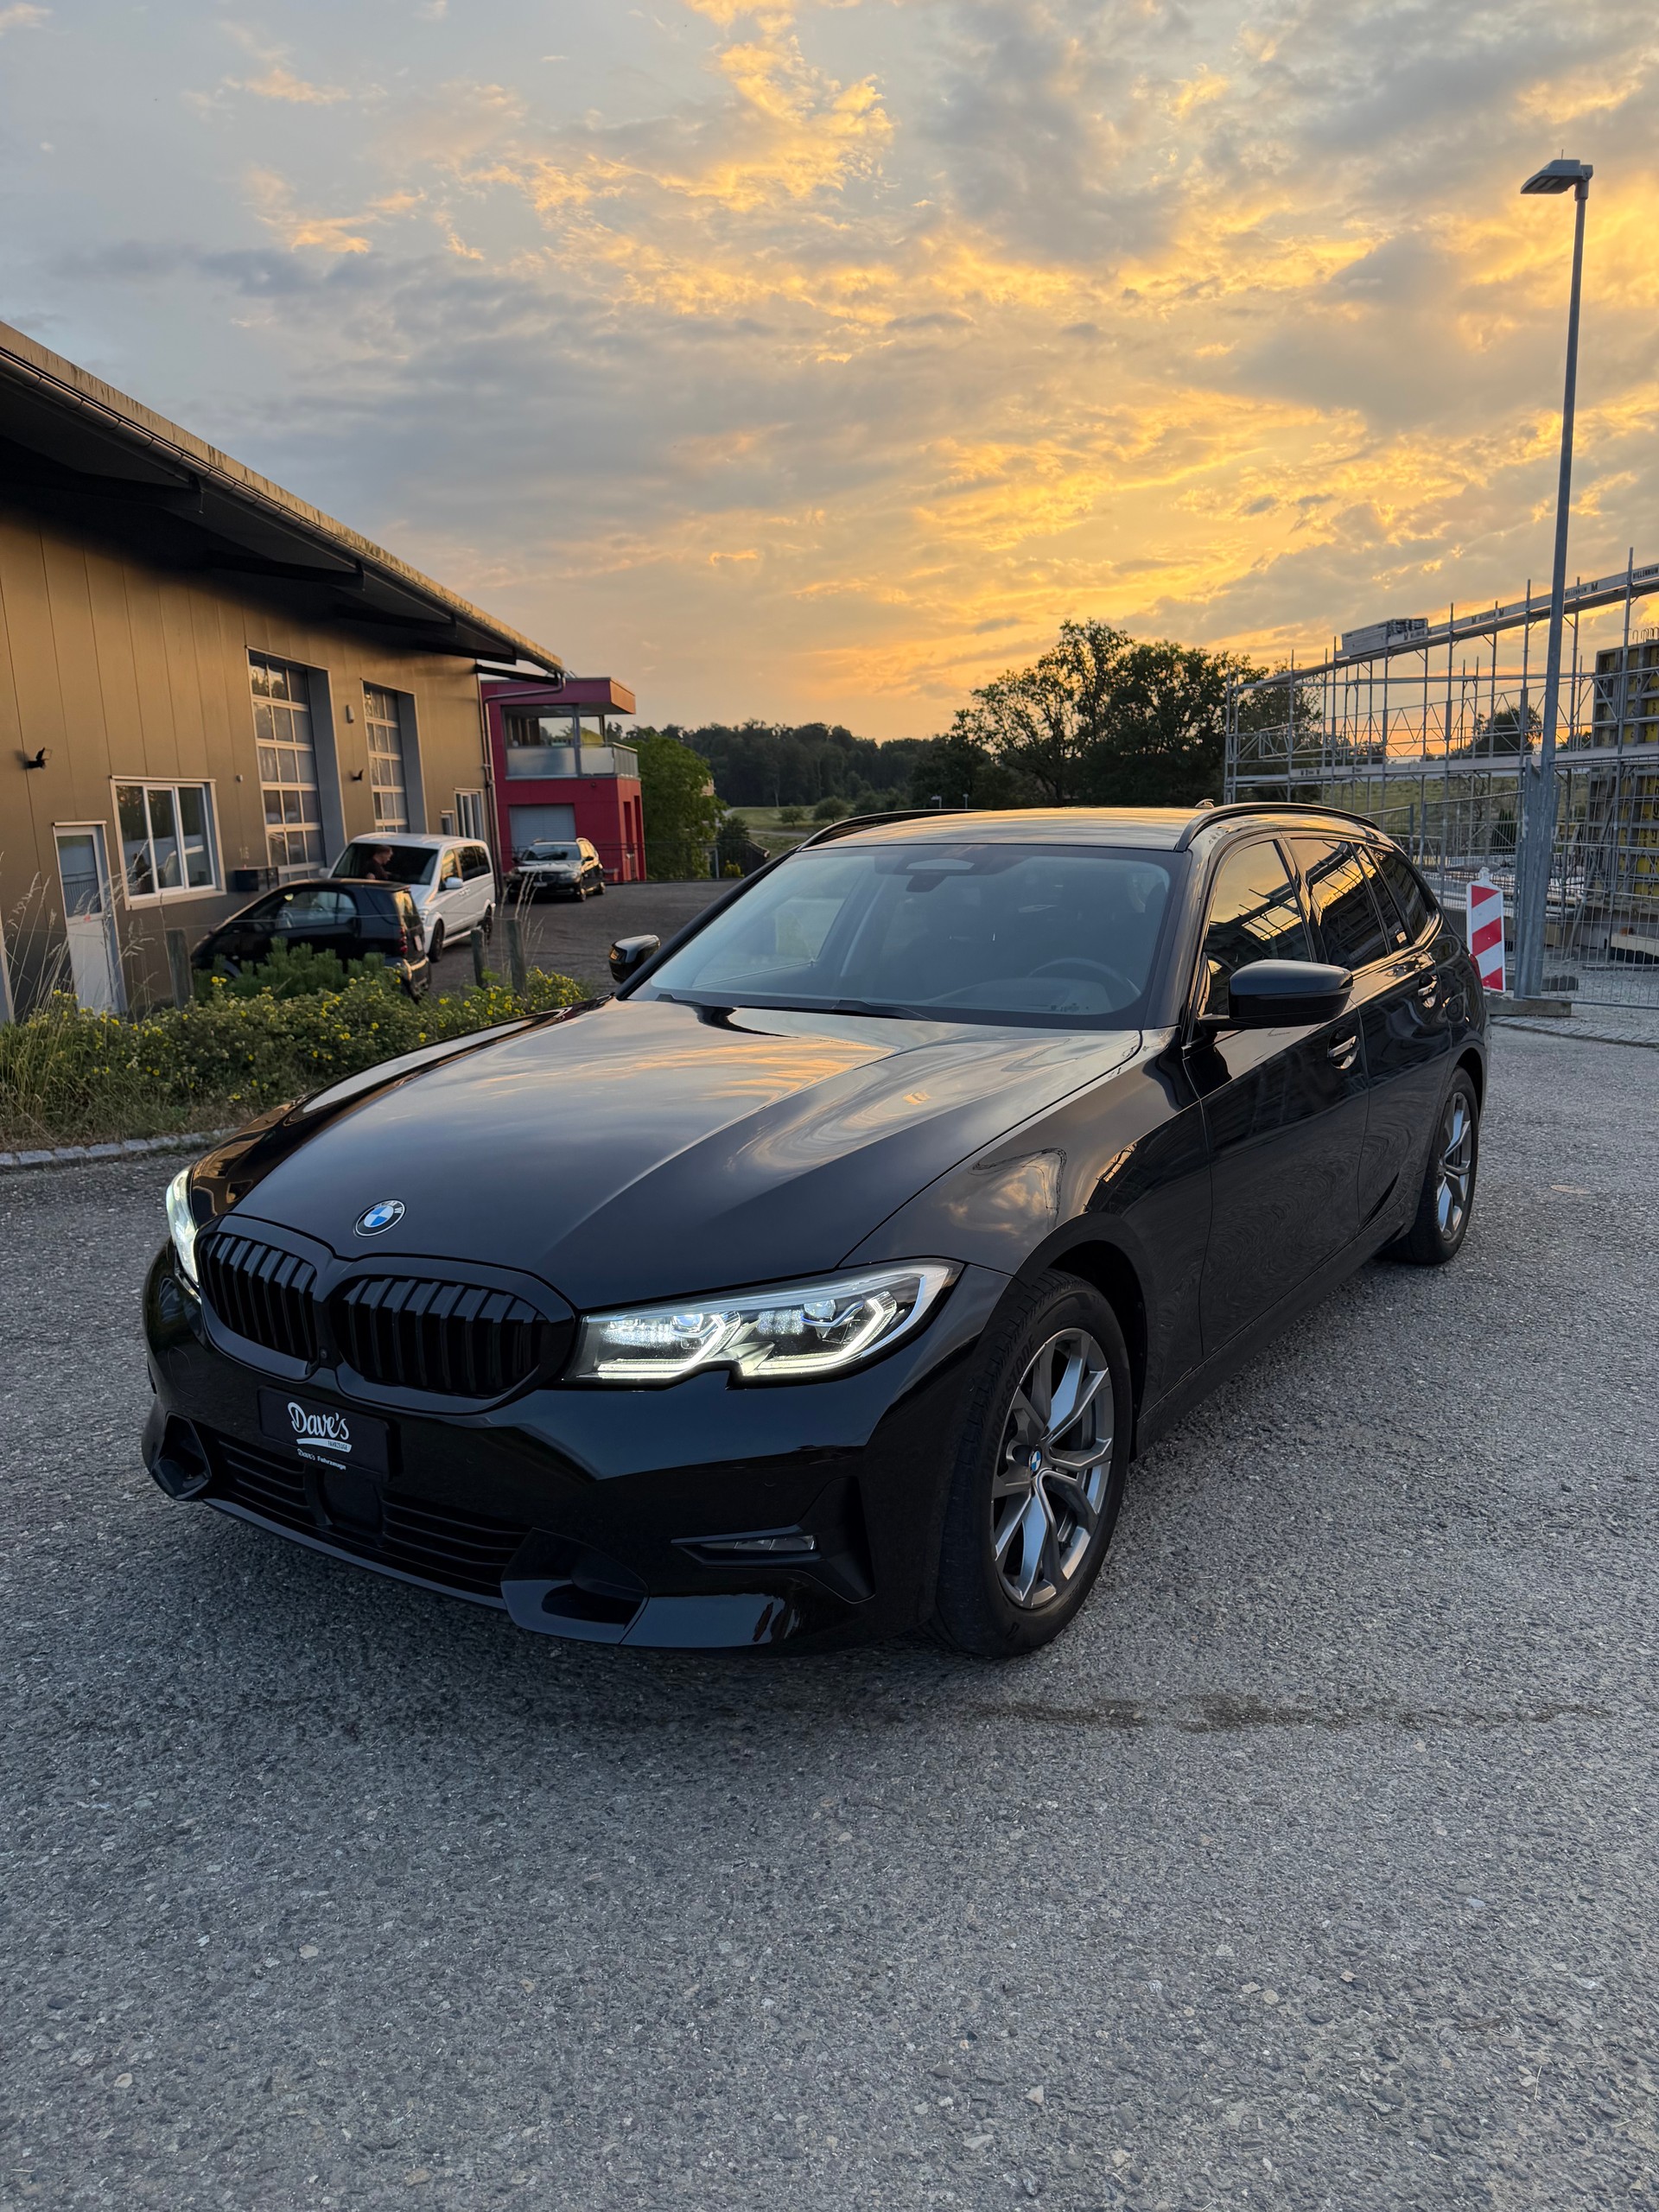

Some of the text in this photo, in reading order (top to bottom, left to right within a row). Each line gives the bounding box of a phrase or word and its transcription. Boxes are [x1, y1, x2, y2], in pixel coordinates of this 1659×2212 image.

[287, 1402, 350, 1440] Dave's
[296, 1448, 346, 1471] Dave's Fahrzeuge
